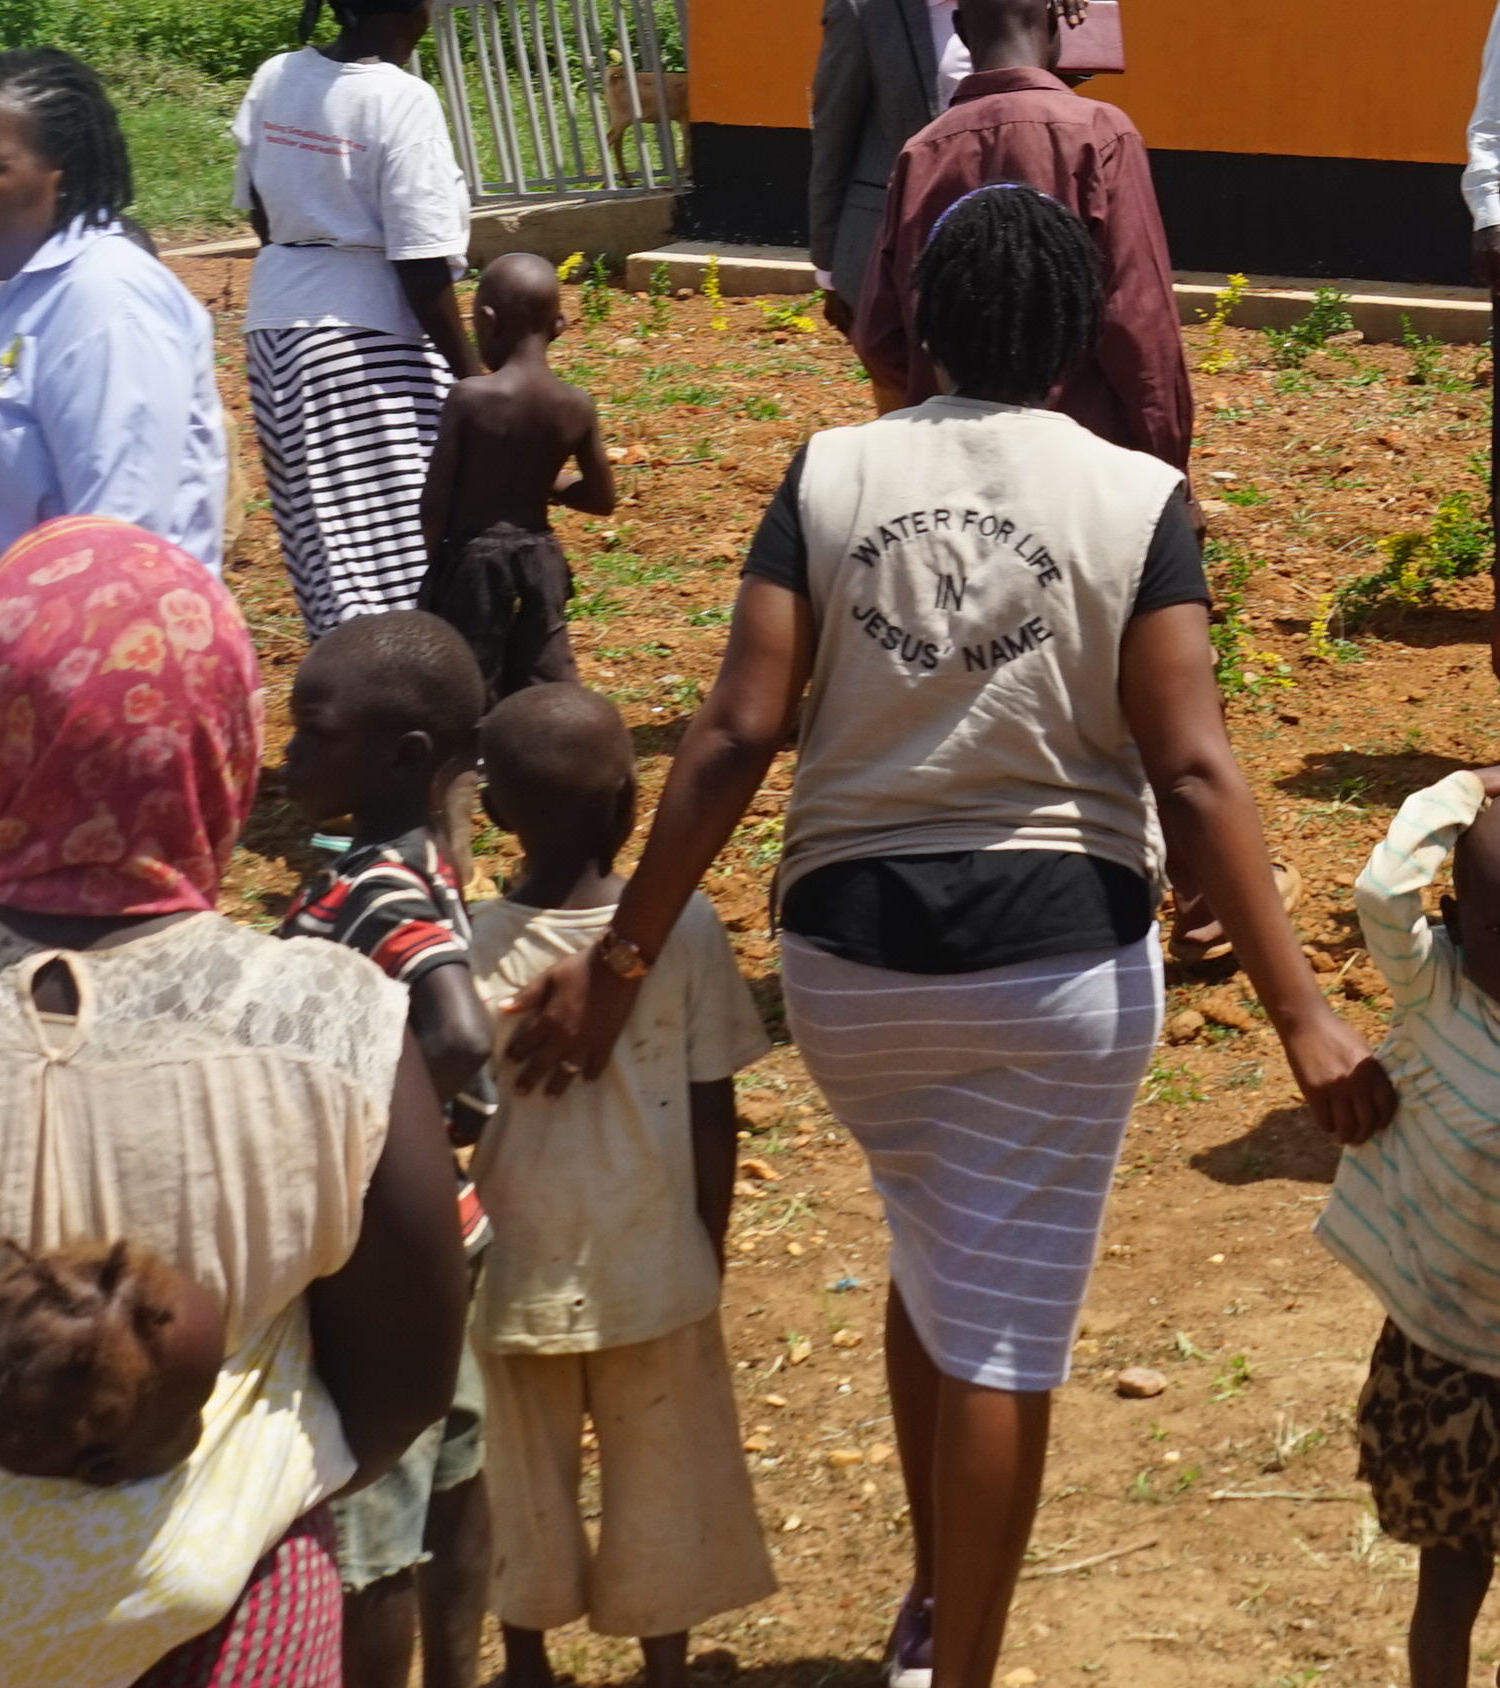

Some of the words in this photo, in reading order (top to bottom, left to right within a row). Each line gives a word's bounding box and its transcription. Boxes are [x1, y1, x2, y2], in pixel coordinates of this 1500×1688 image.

[850, 508, 951, 568] WATER
[961, 509, 1016, 544] FOR
[1013, 533, 1063, 589] LIFE
[935, 573, 968, 612] IN
[962, 616, 1054, 672] NAME
